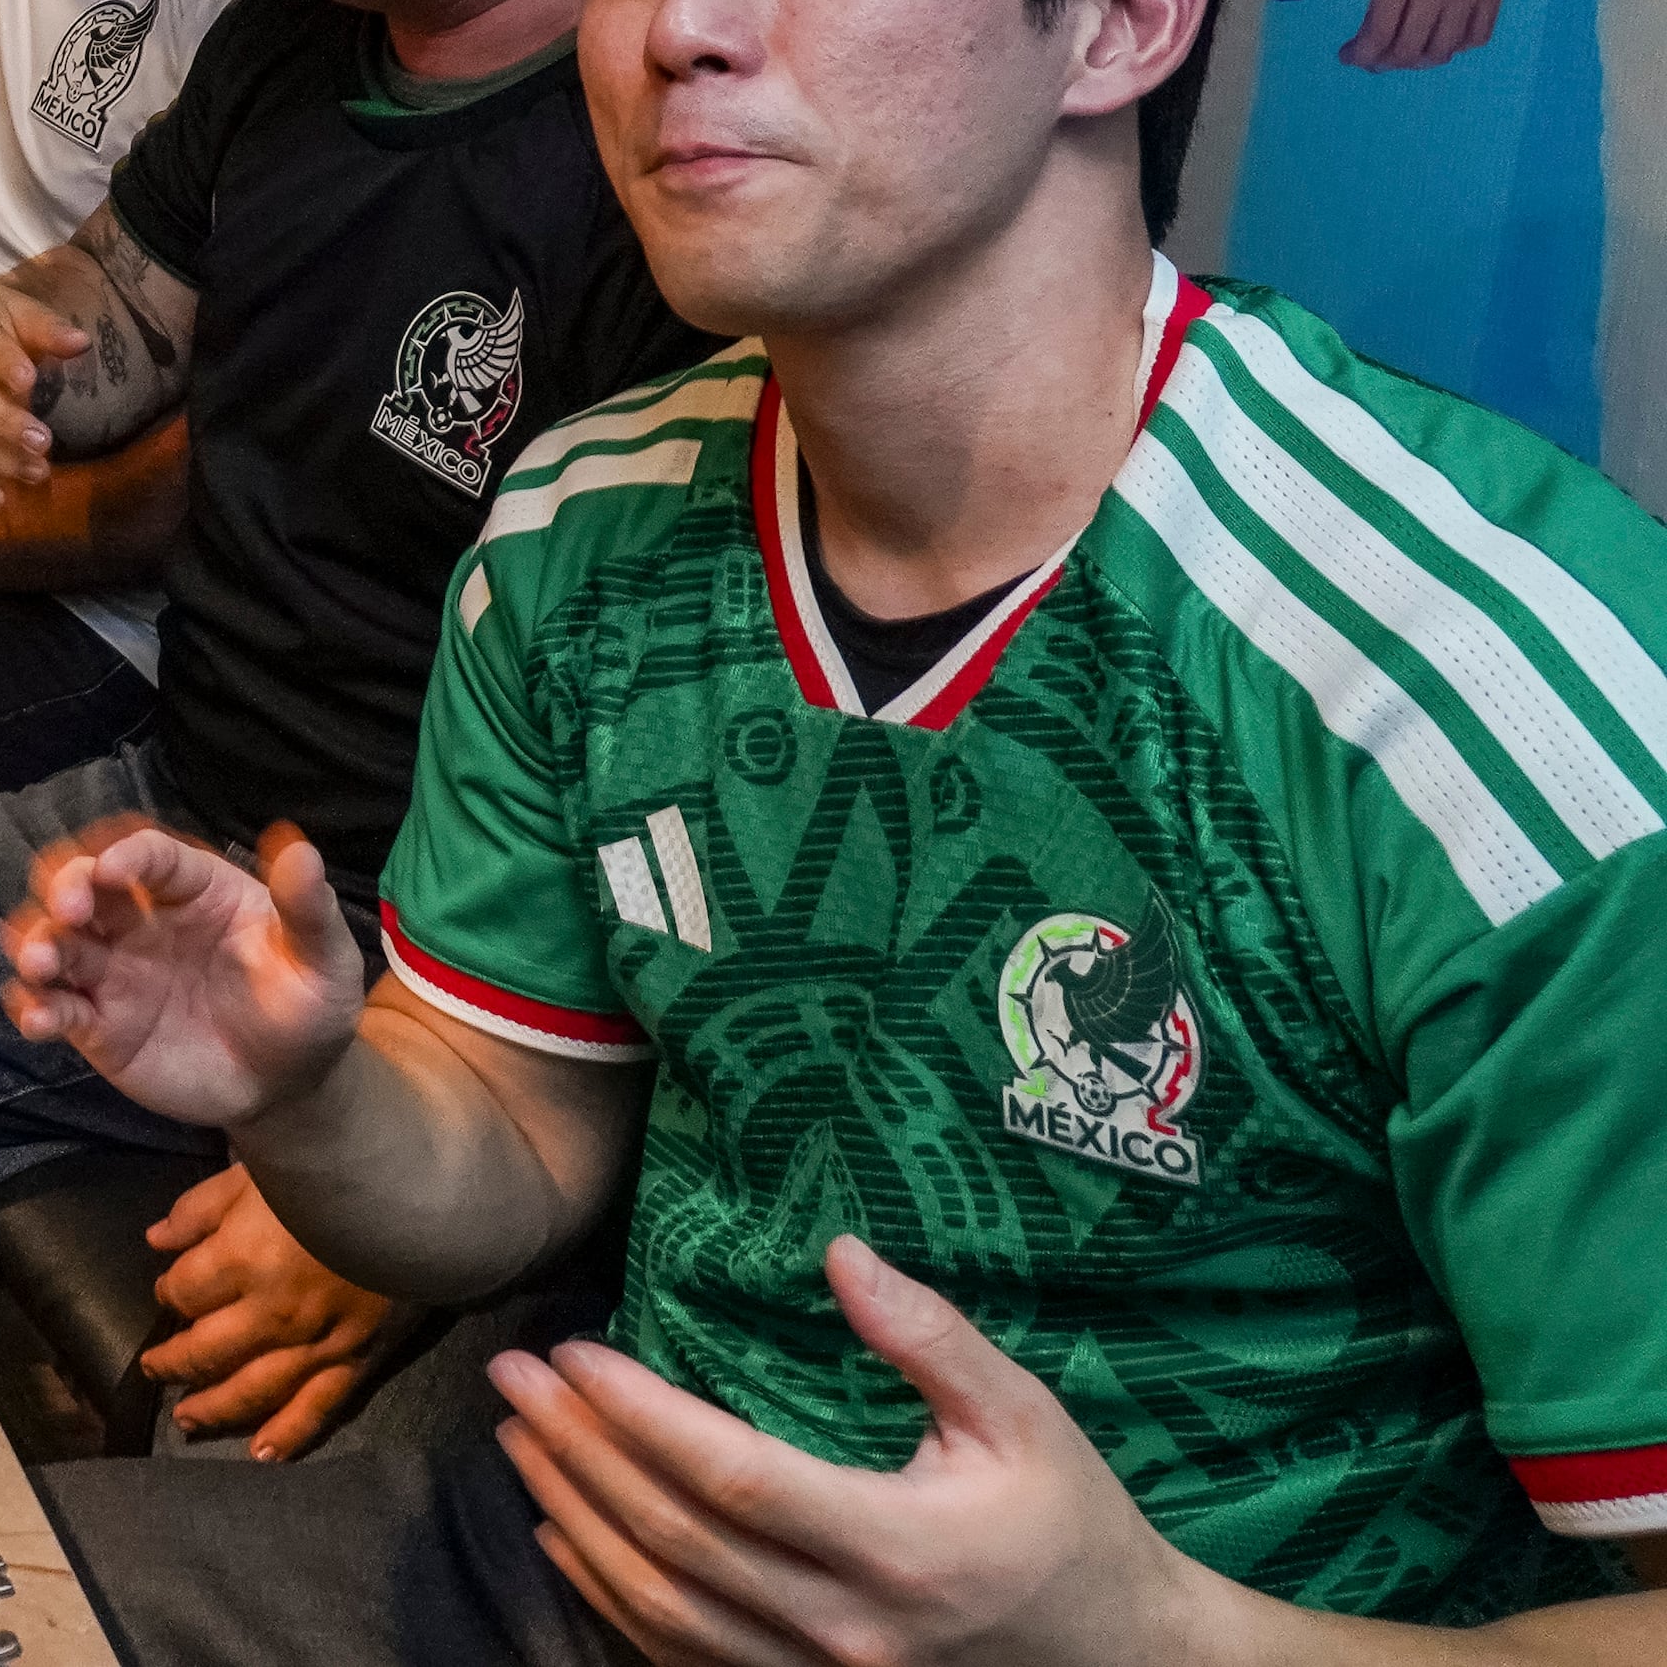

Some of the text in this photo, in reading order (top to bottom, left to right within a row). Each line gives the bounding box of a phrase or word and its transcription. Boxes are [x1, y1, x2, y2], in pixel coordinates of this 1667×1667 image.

[35, 88, 97, 139] MÉXICO
[376, 406, 482, 485] MÉXICO
[1008, 1093, 1192, 1175] MÉXICO
